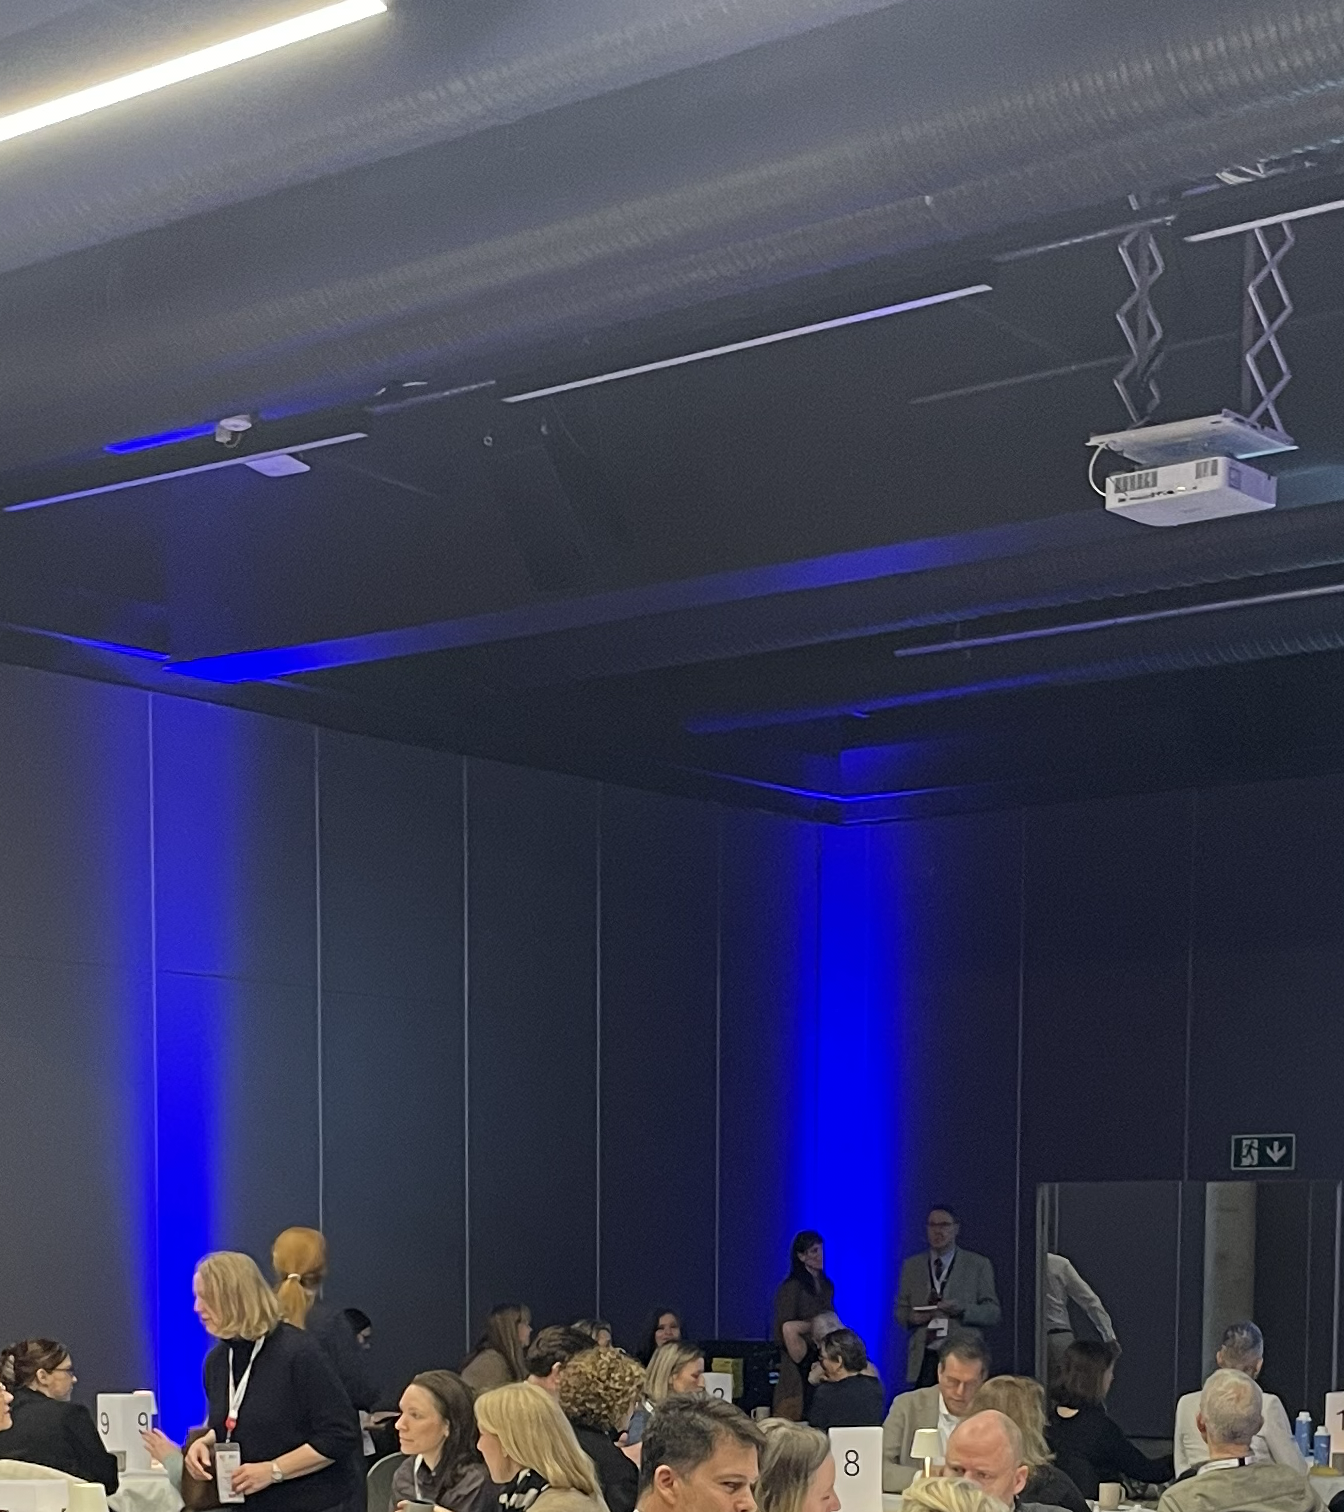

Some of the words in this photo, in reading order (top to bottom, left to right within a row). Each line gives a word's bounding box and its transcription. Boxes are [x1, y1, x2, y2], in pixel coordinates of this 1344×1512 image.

[99, 1411, 110, 1435] 9
[137, 1411, 149, 1435] 9
[843, 1449, 860, 1477] 8
